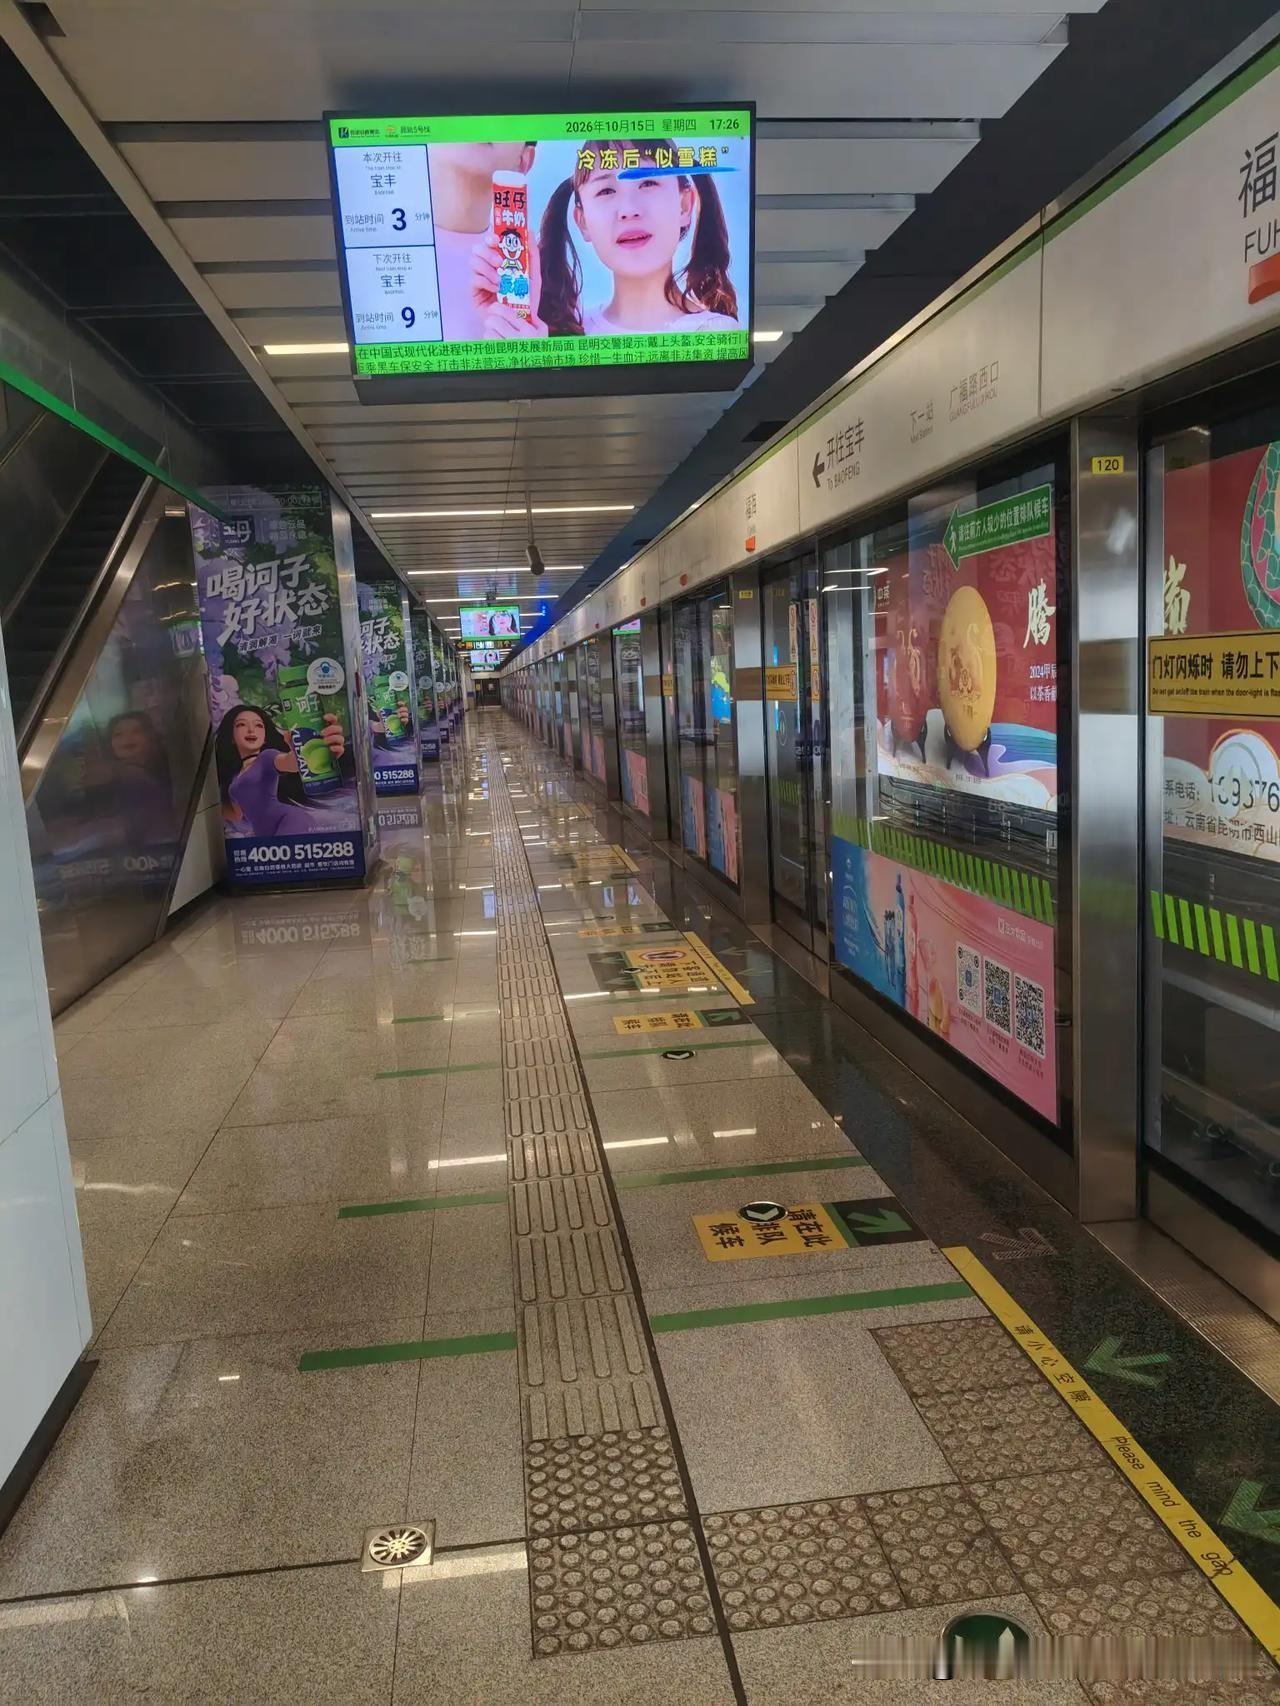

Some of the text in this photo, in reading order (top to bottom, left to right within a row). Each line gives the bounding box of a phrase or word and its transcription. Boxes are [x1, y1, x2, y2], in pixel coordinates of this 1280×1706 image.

[566, 118, 740, 133] 2026年10月15日 星期四 17:26
[363, 152, 402, 163] 本次开往
[371, 173, 397, 188] 宝丰
[1238, 131, 1279, 219] 福
[493, 190, 527, 209] 旺仔
[345, 207, 431, 231] 到站时间 3 分钟
[373, 253, 412, 264] 下次开往
[380, 274, 406, 288] 宝丰
[355, 306, 439, 328] 到站时间 9 分钟
[910, 401, 934, 432] 下一站
[826, 417, 865, 470] 开往宝丰
[1097, 460, 1120, 472] 120
[206, 554, 311, 601] 喝诃子
[216, 582, 330, 647] 好状态
[1023, 578, 1056, 648] 腾
[1152, 650, 1280, 680] 门灯闪烁时 请勿上下
[382, 769, 415, 780] 515288
[1185, 811, 1280, 846] 云南省昆明市西山
[248, 841, 354, 863] 4000 515288
[708, 1221, 745, 1249] 候车
[787, 1208, 833, 1248] 请在此
[1014, 1325, 1091, 1403] 请小心空隙
[1112, 1436, 1233, 1578] Please mind the gap
